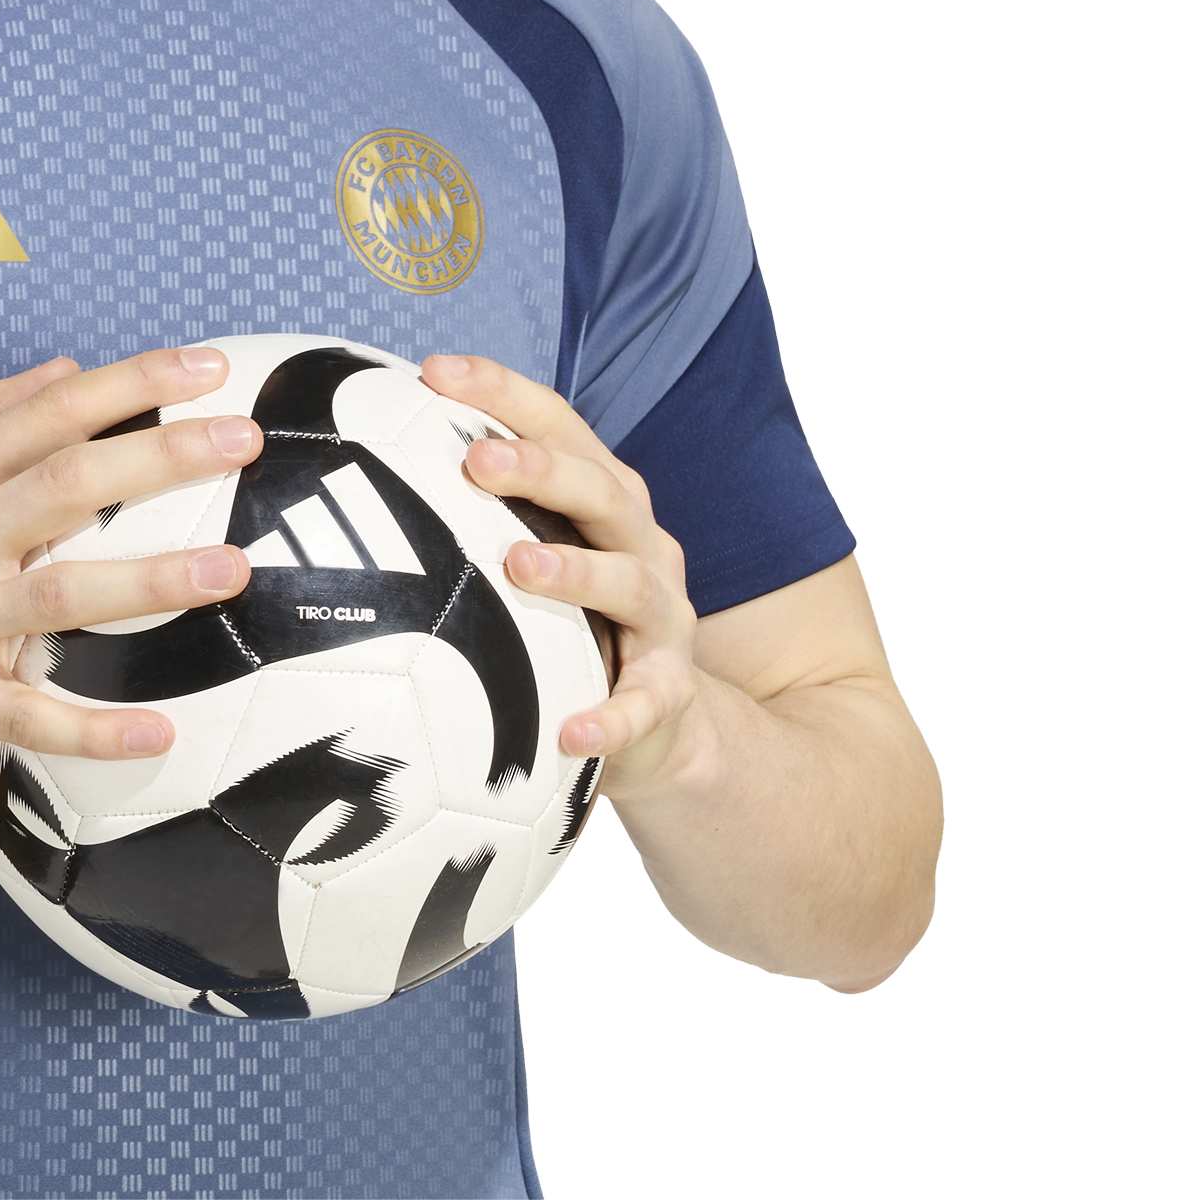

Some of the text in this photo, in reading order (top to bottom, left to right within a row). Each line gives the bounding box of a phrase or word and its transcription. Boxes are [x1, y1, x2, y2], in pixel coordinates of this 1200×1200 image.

[349, 142, 470, 206] FC BAYERN
[296, 606, 376, 622] TIRO CLUB
